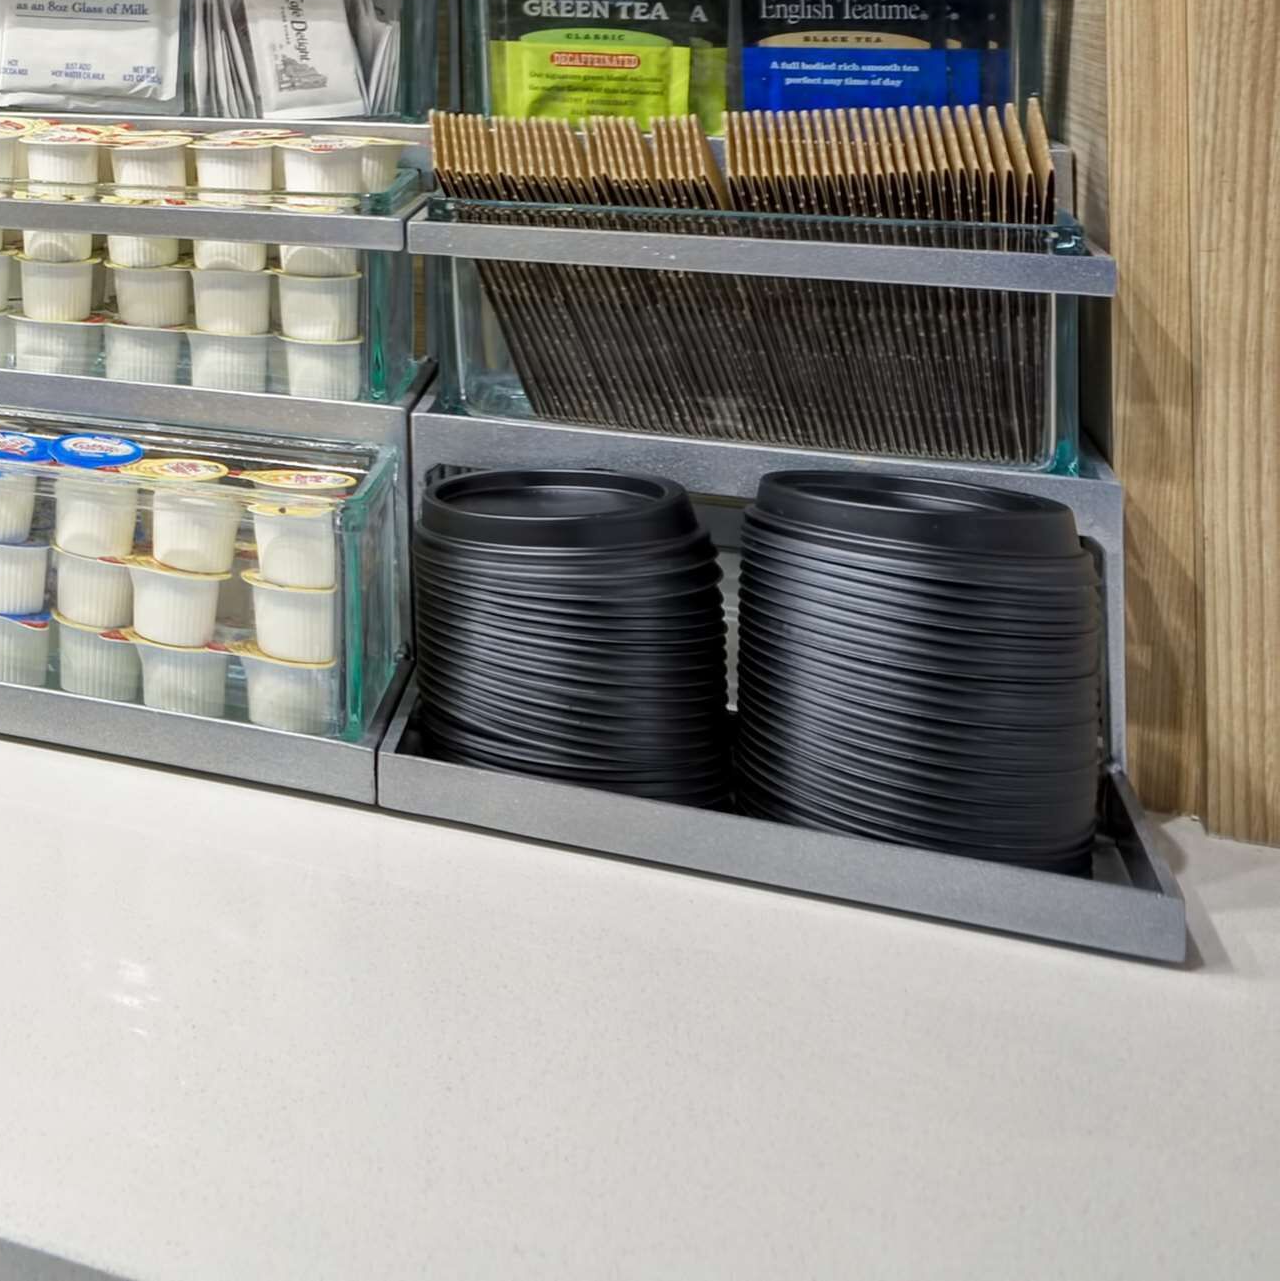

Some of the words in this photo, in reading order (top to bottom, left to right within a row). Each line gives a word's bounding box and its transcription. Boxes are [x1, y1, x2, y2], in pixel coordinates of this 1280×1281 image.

[16, 2, 28, 10] as
[31, 3, 44, 11] an
[47, 1, 67, 12] 8oz
[72, 3, 103, 14] Glass
[106, 3, 120, 14] of
[121, 3, 149, 15] Milk
[523, 0, 610, 19] GREEN
[615, 1, 669, 20] TEA
[565, 33, 625, 41] CLASSIC
[803, 35, 849, 43] BLACK
[770, 61, 779, 69] A
[781, 61, 799, 70] full
[801, 62, 836, 71] bodied
[838, 62, 860, 72] rich
[861, 63, 901, 72] smooth
[785, 76, 821, 86] perfect
[822, 78, 843, 87] any
[844, 77, 868, 86] time
[870, 77, 881, 86] of
[882, 78, 903, 88] day
